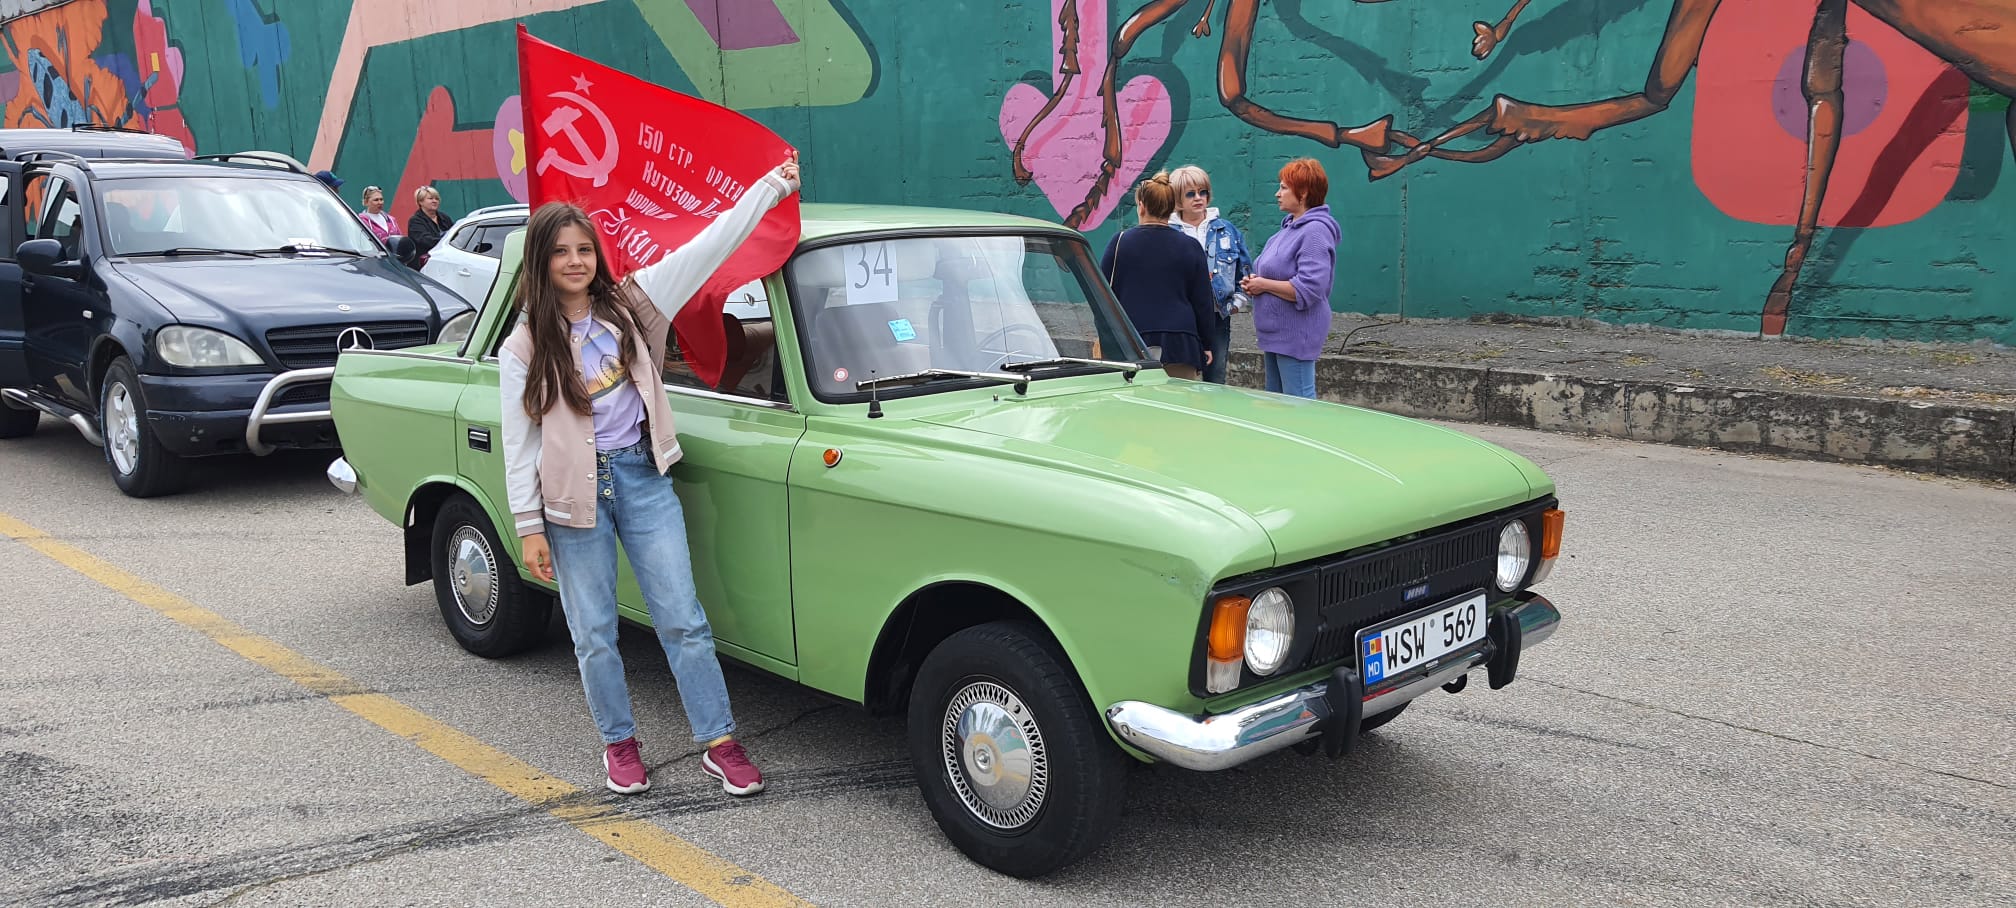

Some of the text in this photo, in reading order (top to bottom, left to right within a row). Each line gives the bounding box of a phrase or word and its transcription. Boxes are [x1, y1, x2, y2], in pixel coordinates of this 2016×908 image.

[637, 122, 664, 154] 150
[668, 143, 695, 174] СТР.
[852, 242, 893, 289] 34
[1385, 604, 1476, 670] WSW 569
[1367, 661, 1380, 678] MD
